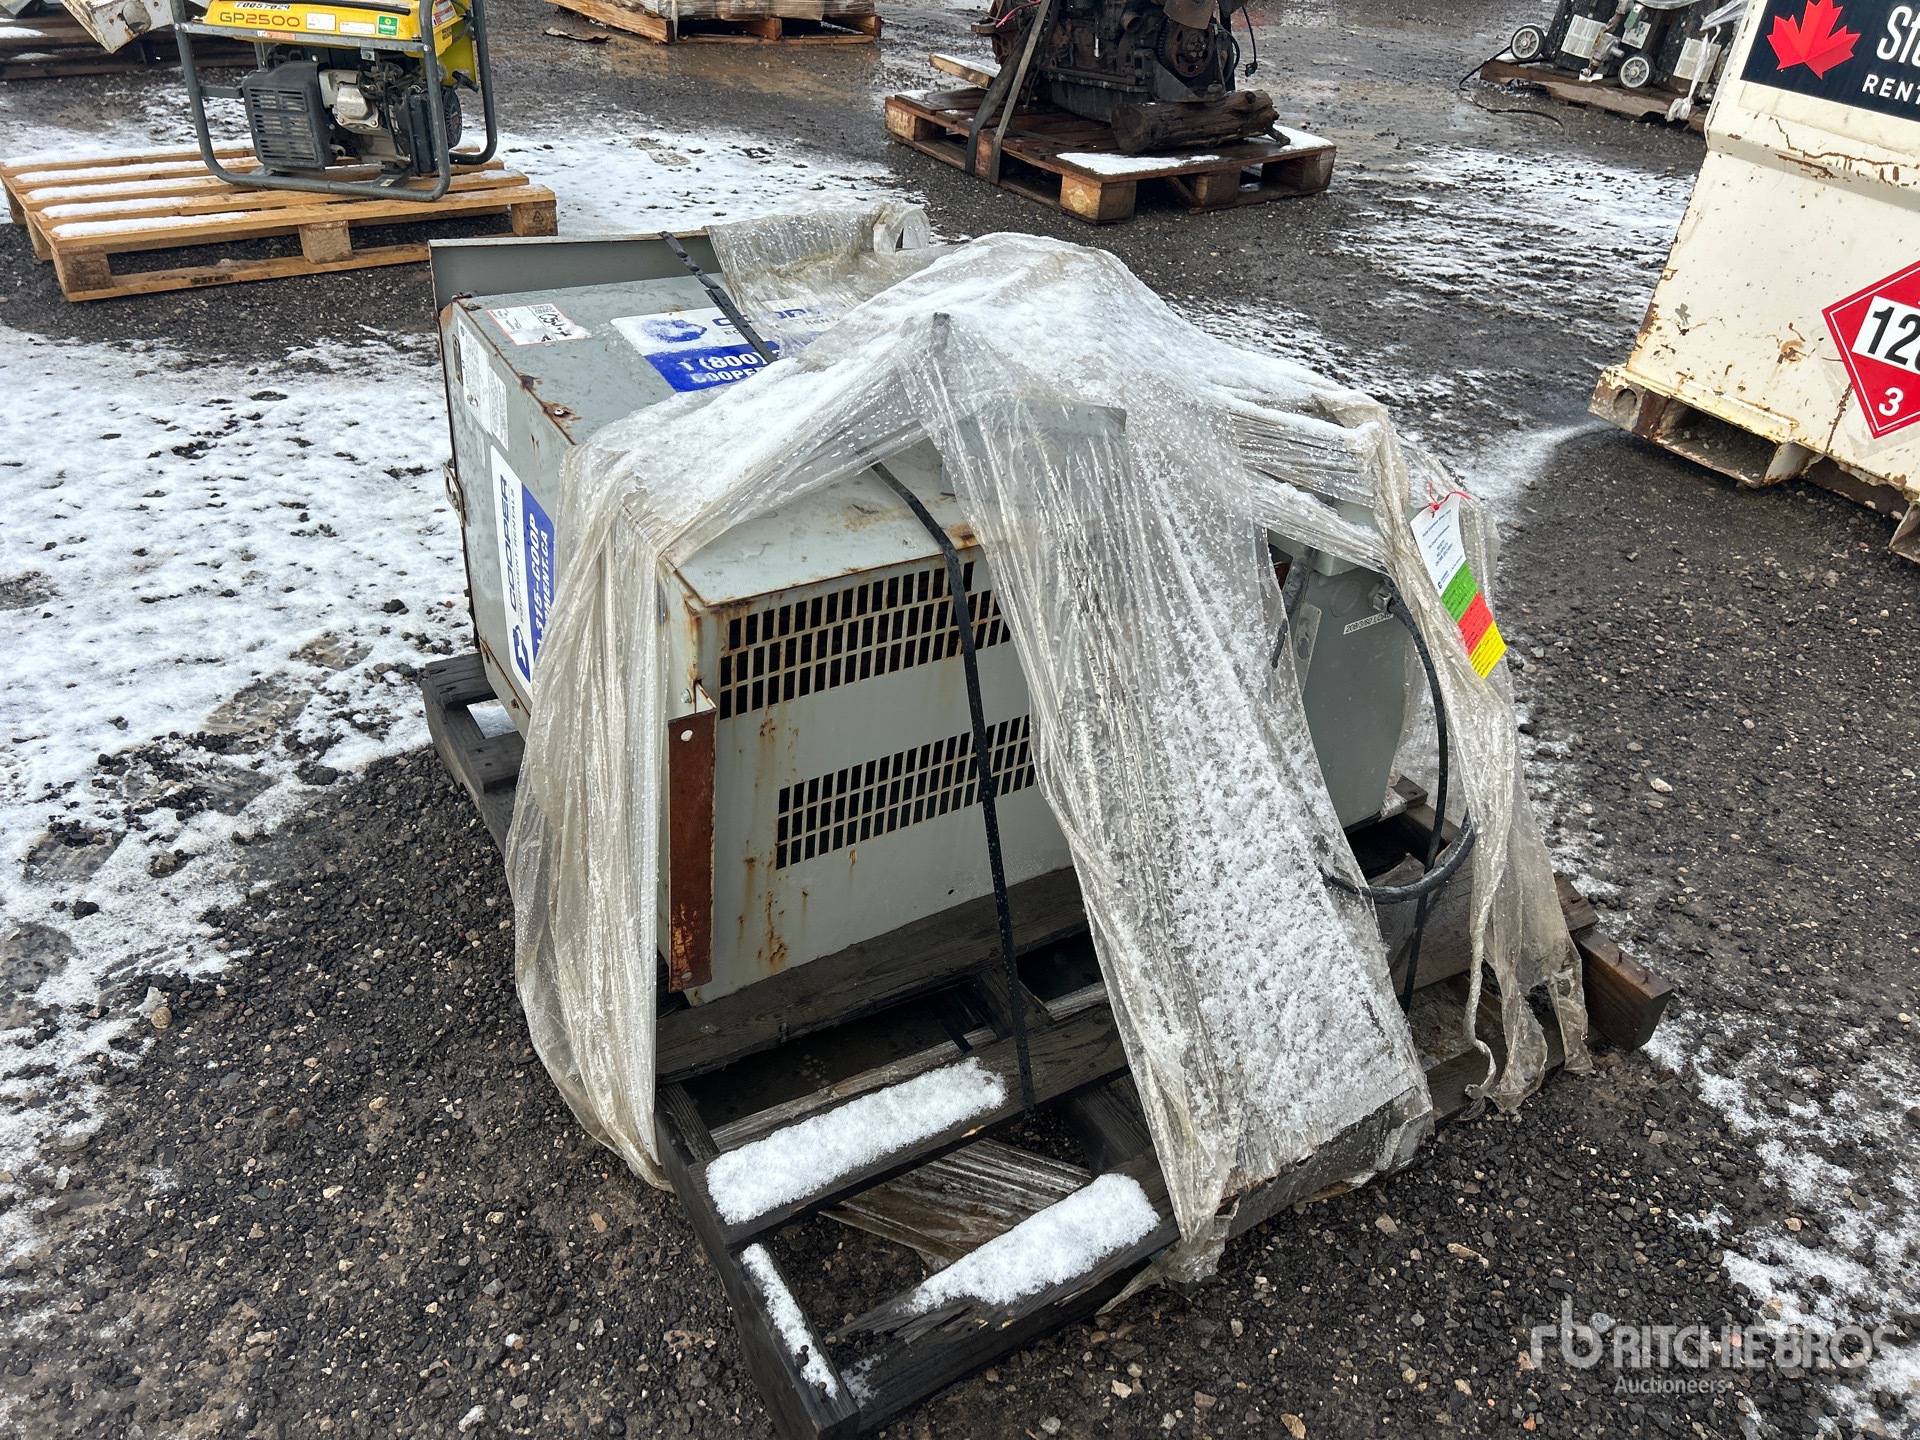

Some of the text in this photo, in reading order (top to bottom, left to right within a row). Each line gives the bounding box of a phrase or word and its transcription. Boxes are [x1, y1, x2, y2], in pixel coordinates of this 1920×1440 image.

[220, 12, 300, 27] GP2500
[699, 352, 767, 371] (800)
[690, 367, 764, 383] COOPE
[1878, 387, 1904, 416] 3
[501, 475, 516, 612] COOPER
[515, 552, 523, 623] EQUIPMENT
